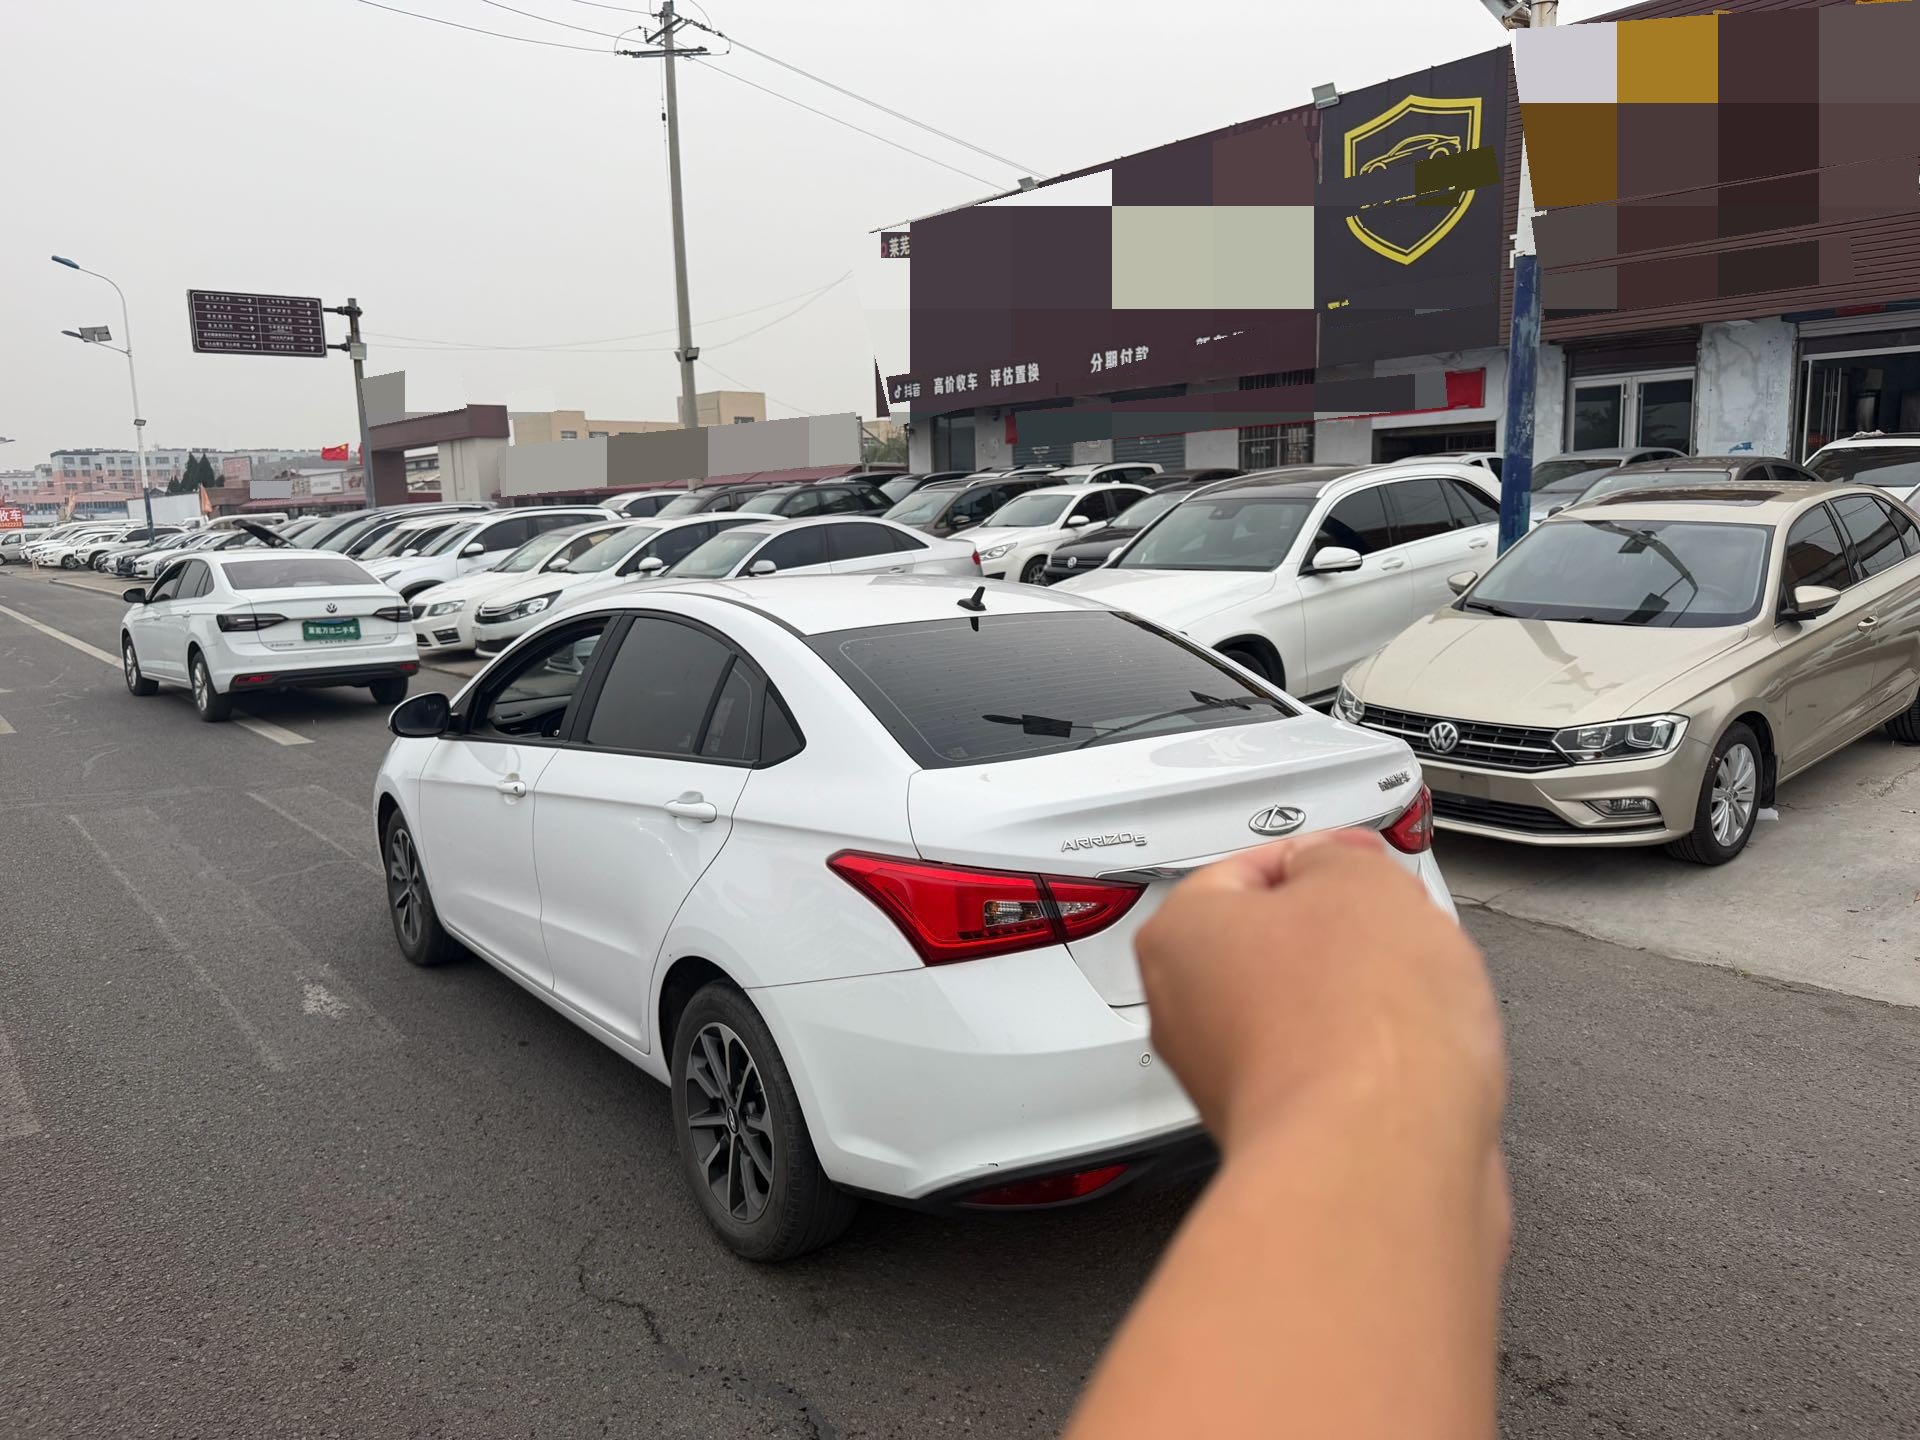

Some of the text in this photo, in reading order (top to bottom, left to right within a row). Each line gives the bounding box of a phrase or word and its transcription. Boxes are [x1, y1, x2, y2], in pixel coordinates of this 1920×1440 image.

[889, 235, 910, 257] 莱芜
[904, 345, 1149, 398] 抖音 高价收车 评估置换 分期付款
